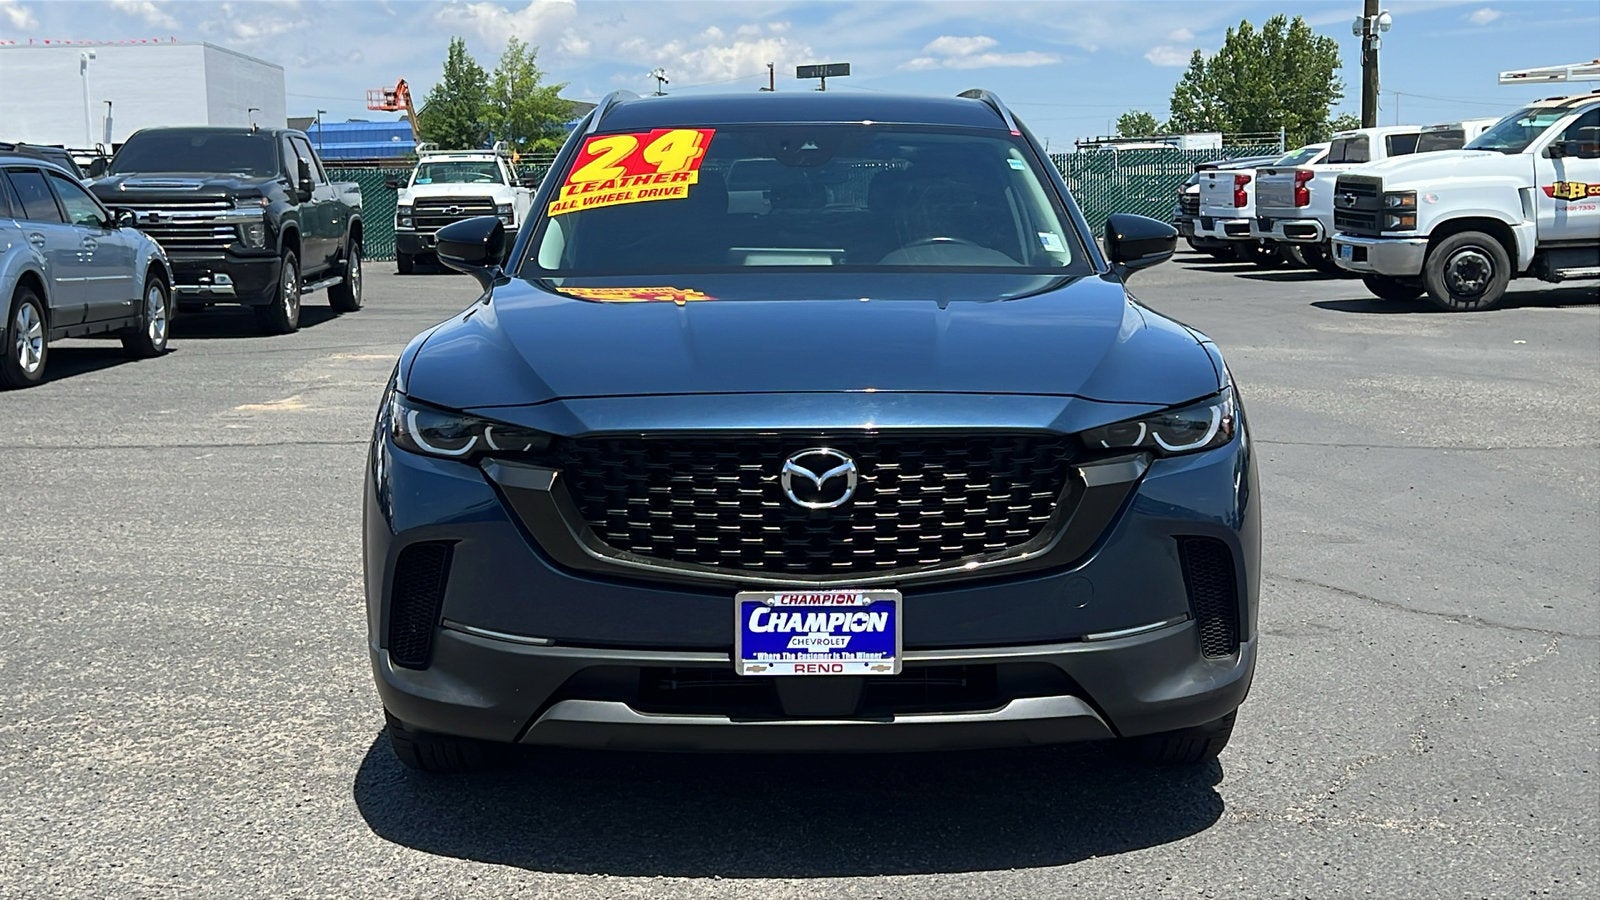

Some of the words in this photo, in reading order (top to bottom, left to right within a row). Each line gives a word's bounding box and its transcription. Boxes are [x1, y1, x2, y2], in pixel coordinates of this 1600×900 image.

[570, 129, 703, 183] 24
[566, 172, 691, 196] LEATHER
[551, 200, 579, 213] ALL
[582, 191, 633, 206] WHEEL
[637, 187, 682, 199] DRIVE
[780, 594, 857, 605] CHAMPION
[749, 606, 889, 633] CHAMPION
[791, 638, 846, 646] CHEVROLET
[782, 652, 795, 660] The
[797, 652, 832, 660] Customer
[842, 652, 855, 660] The
[794, 663, 844, 673] RENO
